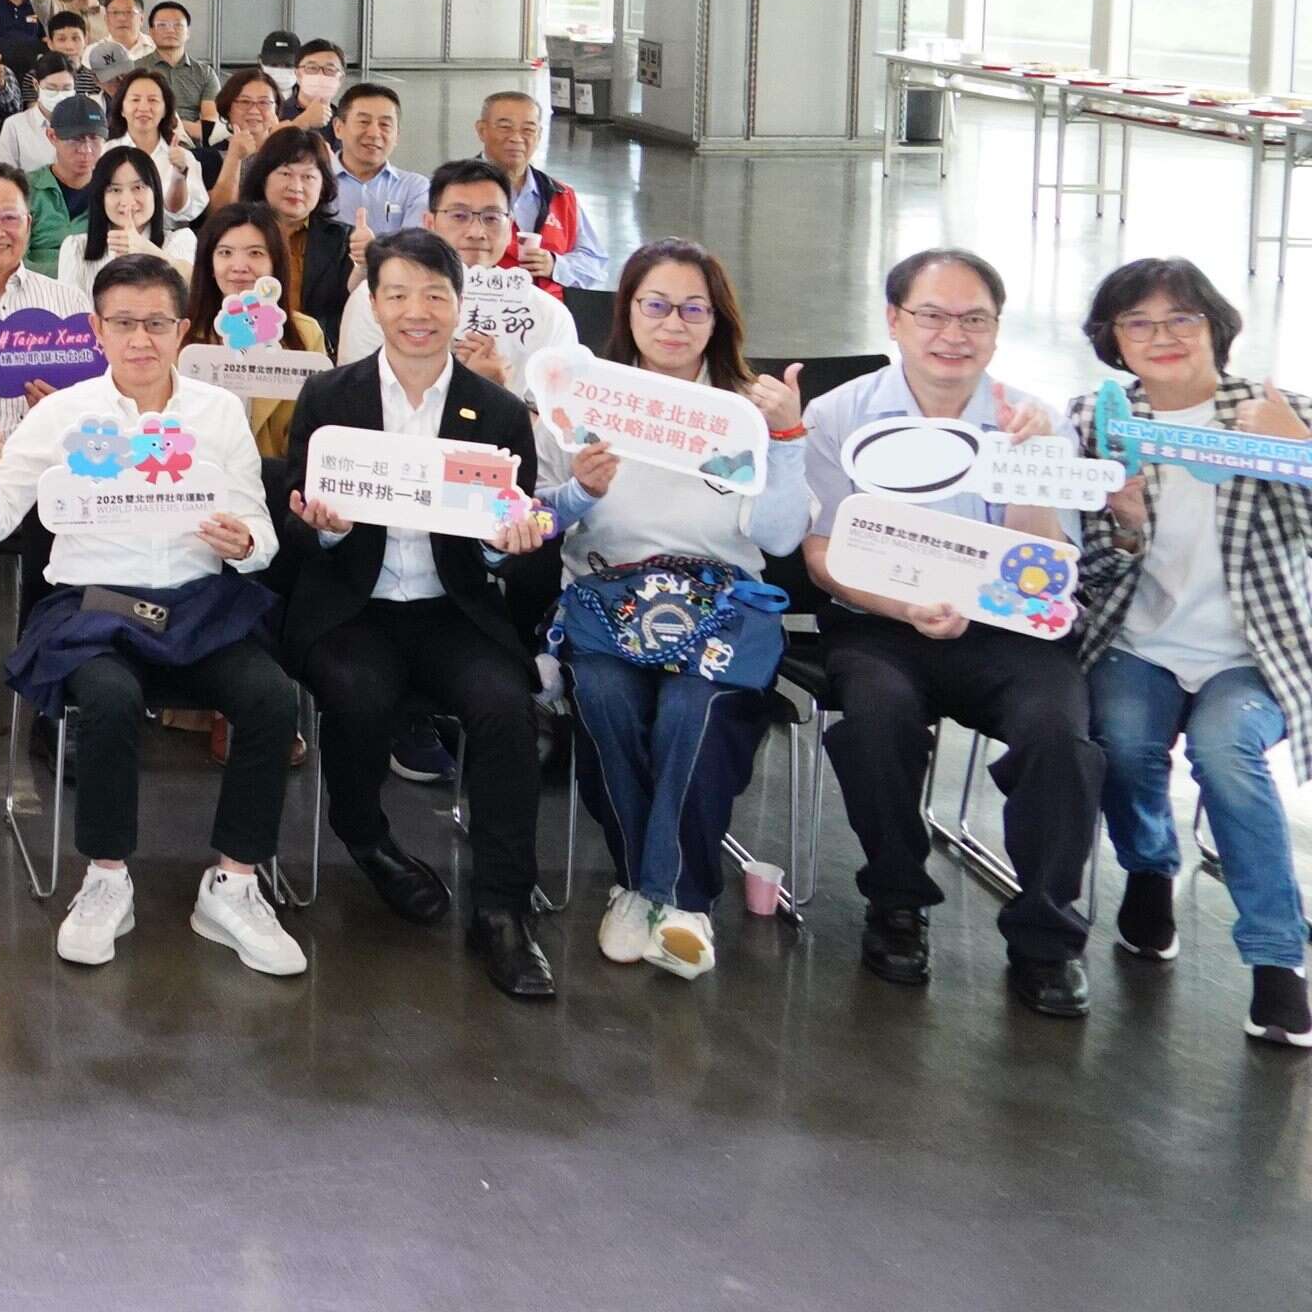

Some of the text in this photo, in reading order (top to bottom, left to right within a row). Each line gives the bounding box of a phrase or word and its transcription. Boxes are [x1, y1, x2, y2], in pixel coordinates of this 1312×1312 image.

[468, 272, 524, 289] 北國際
[55, 328, 91, 345] Xmas
[573, 380, 730, 437] 2025年臺北旅遊
[1108, 419, 1158, 441] NEW
[992, 440, 1065, 458] TAIPEI
[320, 452, 389, 476] 邀你一起
[992, 462, 1115, 483] MARATHON
[96, 492, 215, 504] 2025雙北世界壯年運動會
[319, 476, 432, 507] 和世界挑一場
